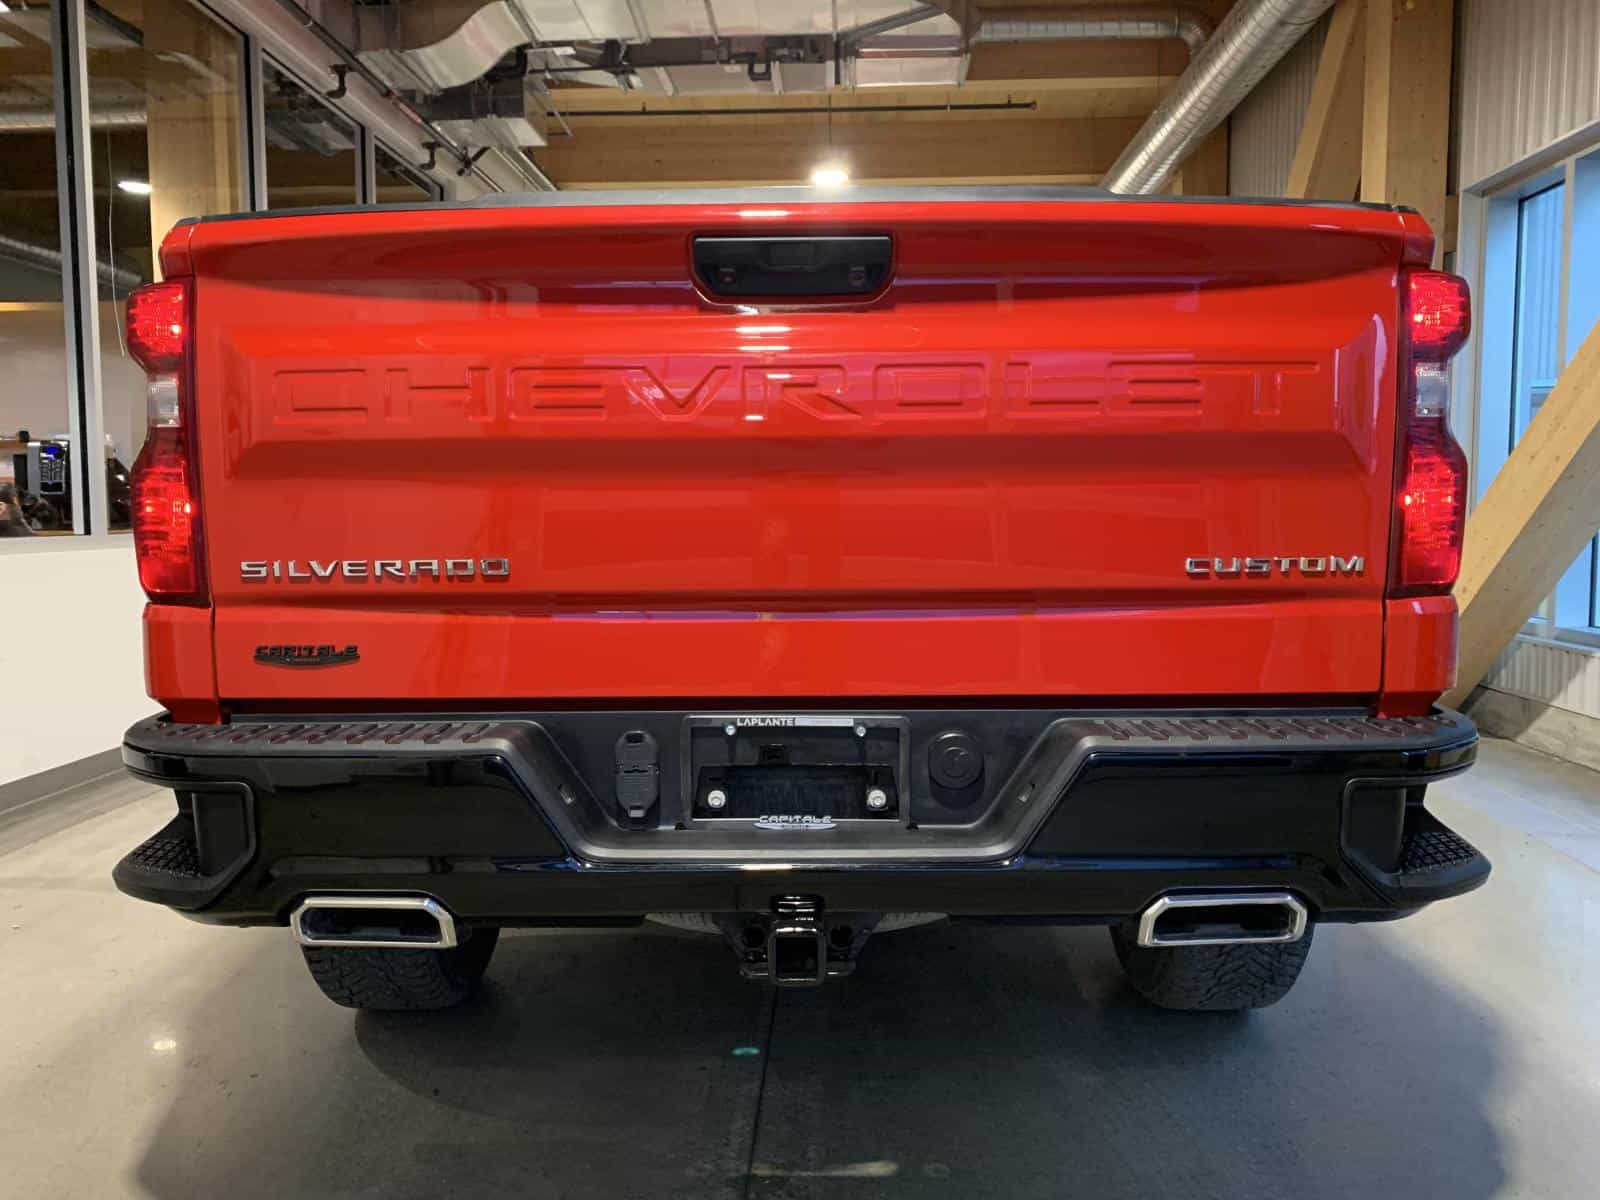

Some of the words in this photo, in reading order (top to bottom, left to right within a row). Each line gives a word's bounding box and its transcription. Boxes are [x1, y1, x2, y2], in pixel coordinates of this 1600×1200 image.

[273, 361, 1320, 425] CHEVROLET
[240, 559, 510, 580] SILVERADO
[1184, 555, 1365, 575] CUSTOM
[736, 717, 793, 727] LAPLANTE
[759, 815, 832, 824] CAPITALE
